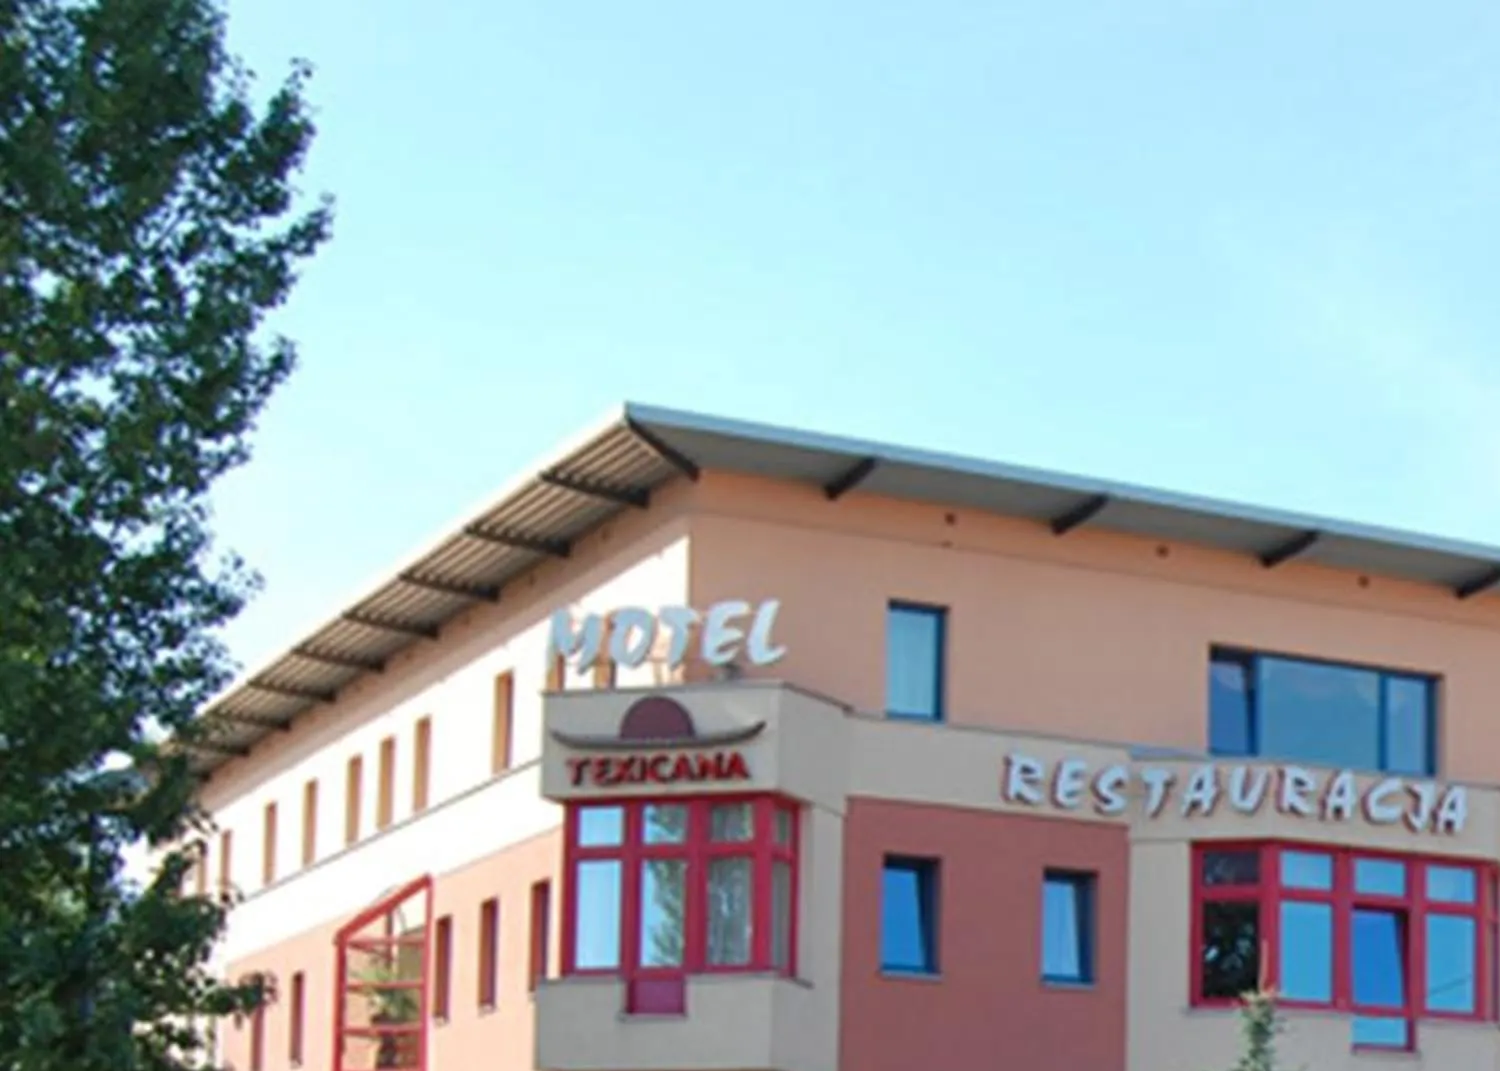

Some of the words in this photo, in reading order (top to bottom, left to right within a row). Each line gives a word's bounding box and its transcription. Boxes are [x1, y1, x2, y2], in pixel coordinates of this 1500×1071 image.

[549, 600, 787, 675] MOTEL
[566, 751, 751, 786] TEXICANA
[1003, 753, 1469, 834] RESTAURACJA
